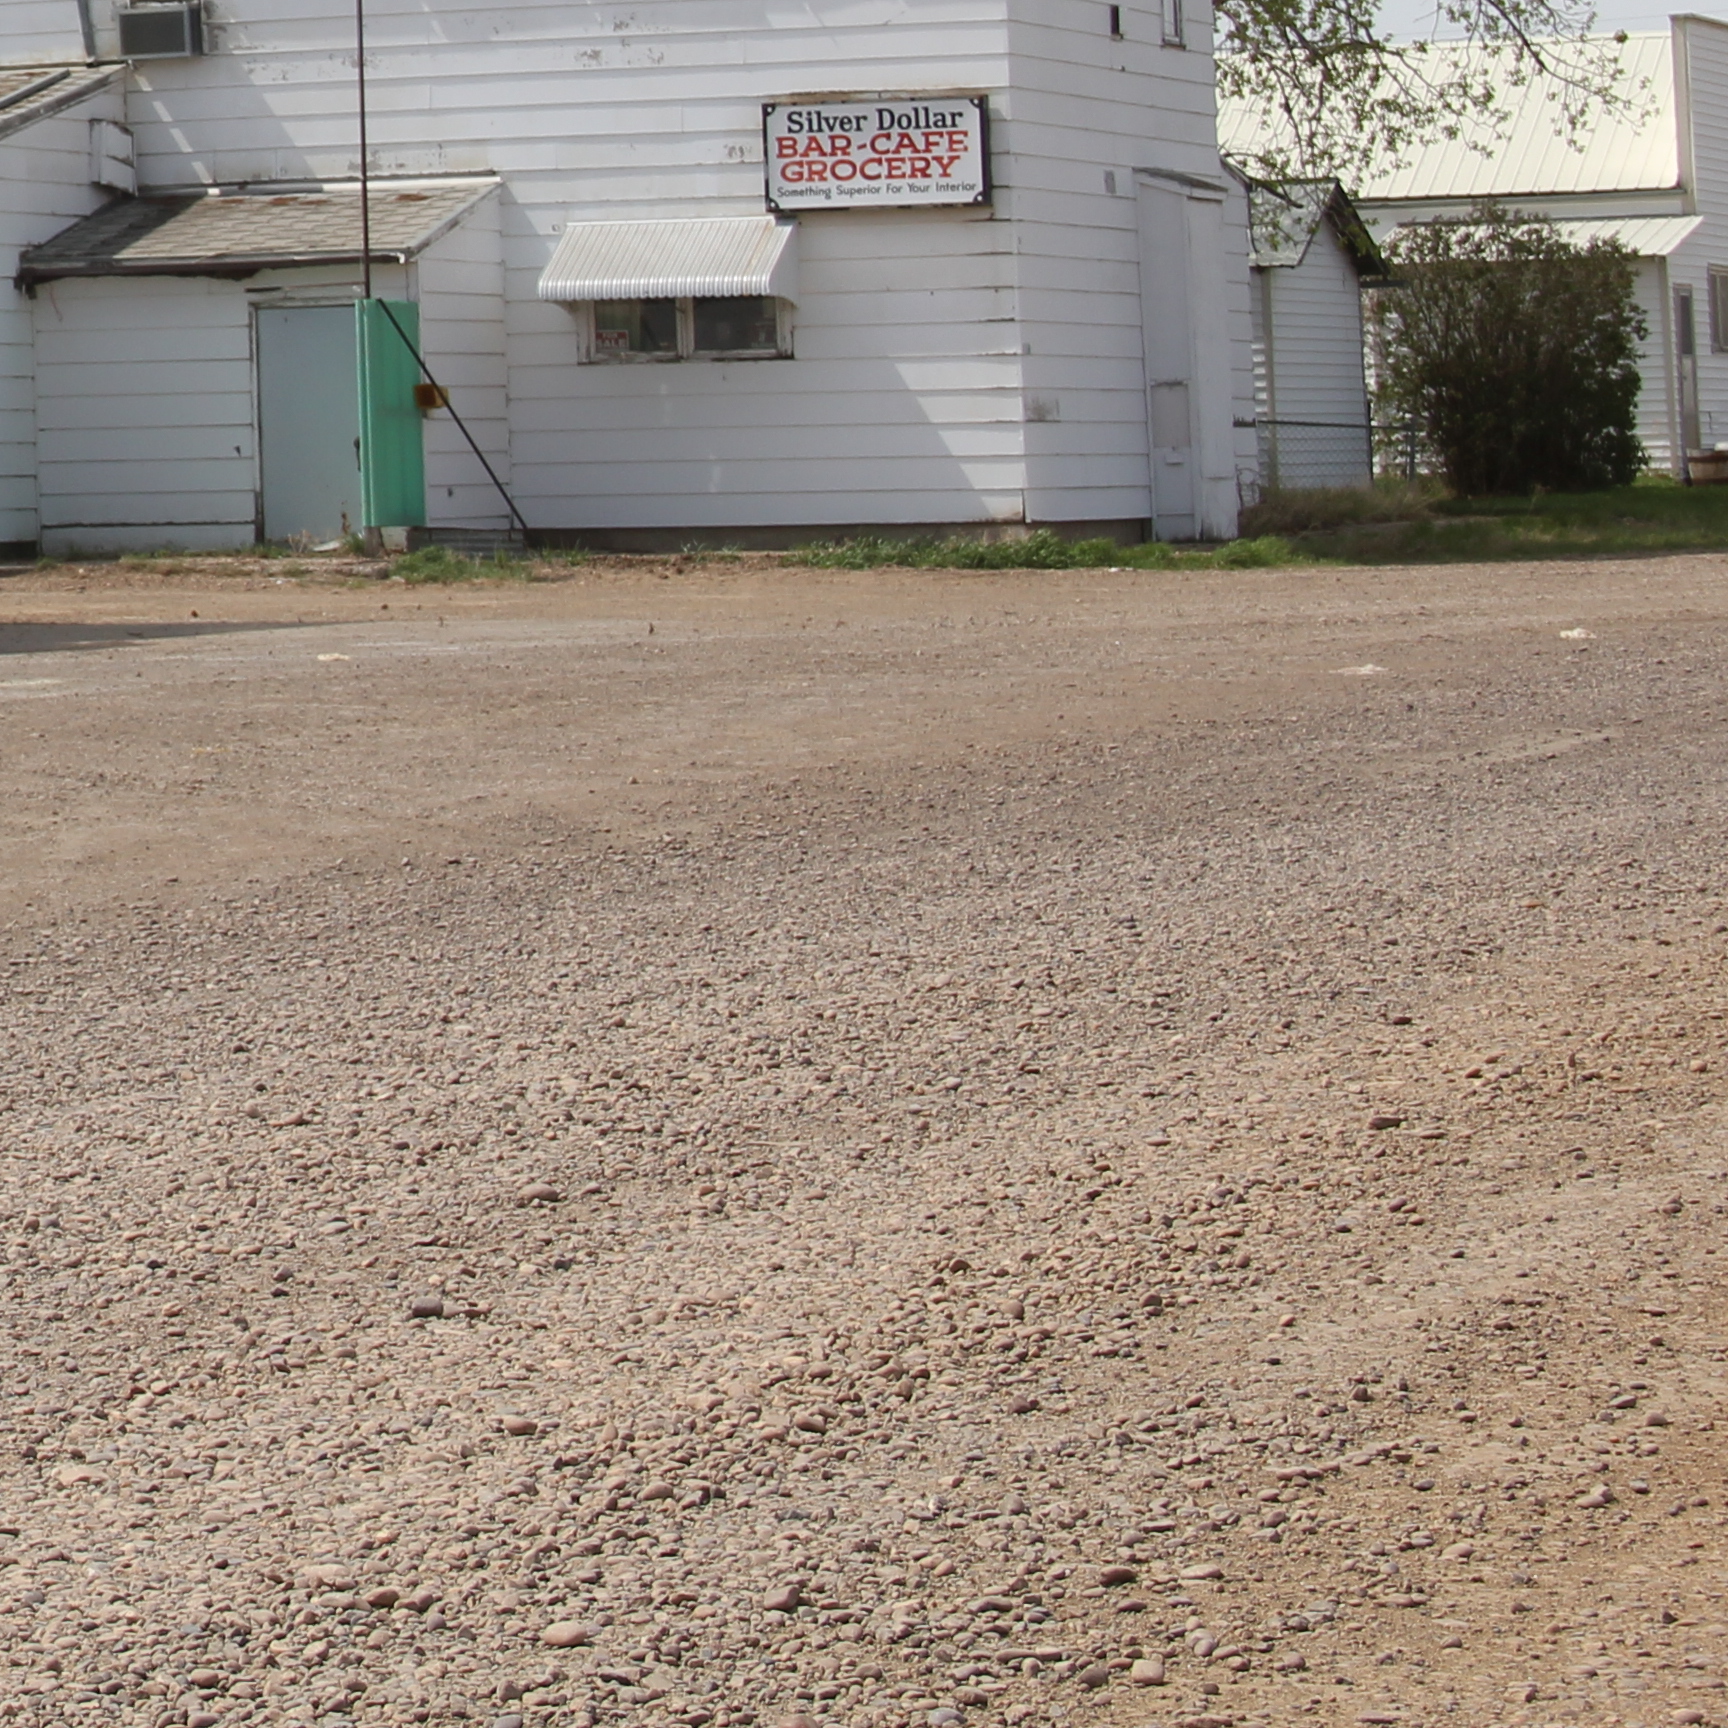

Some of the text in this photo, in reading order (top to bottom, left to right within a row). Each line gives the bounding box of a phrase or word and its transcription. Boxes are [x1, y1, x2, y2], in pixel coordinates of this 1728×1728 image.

[786, 106, 964, 134] Silver Dollar
[780, 155, 961, 183] GROCERY
[777, 181, 977, 200] Something Superior For Your Interior
